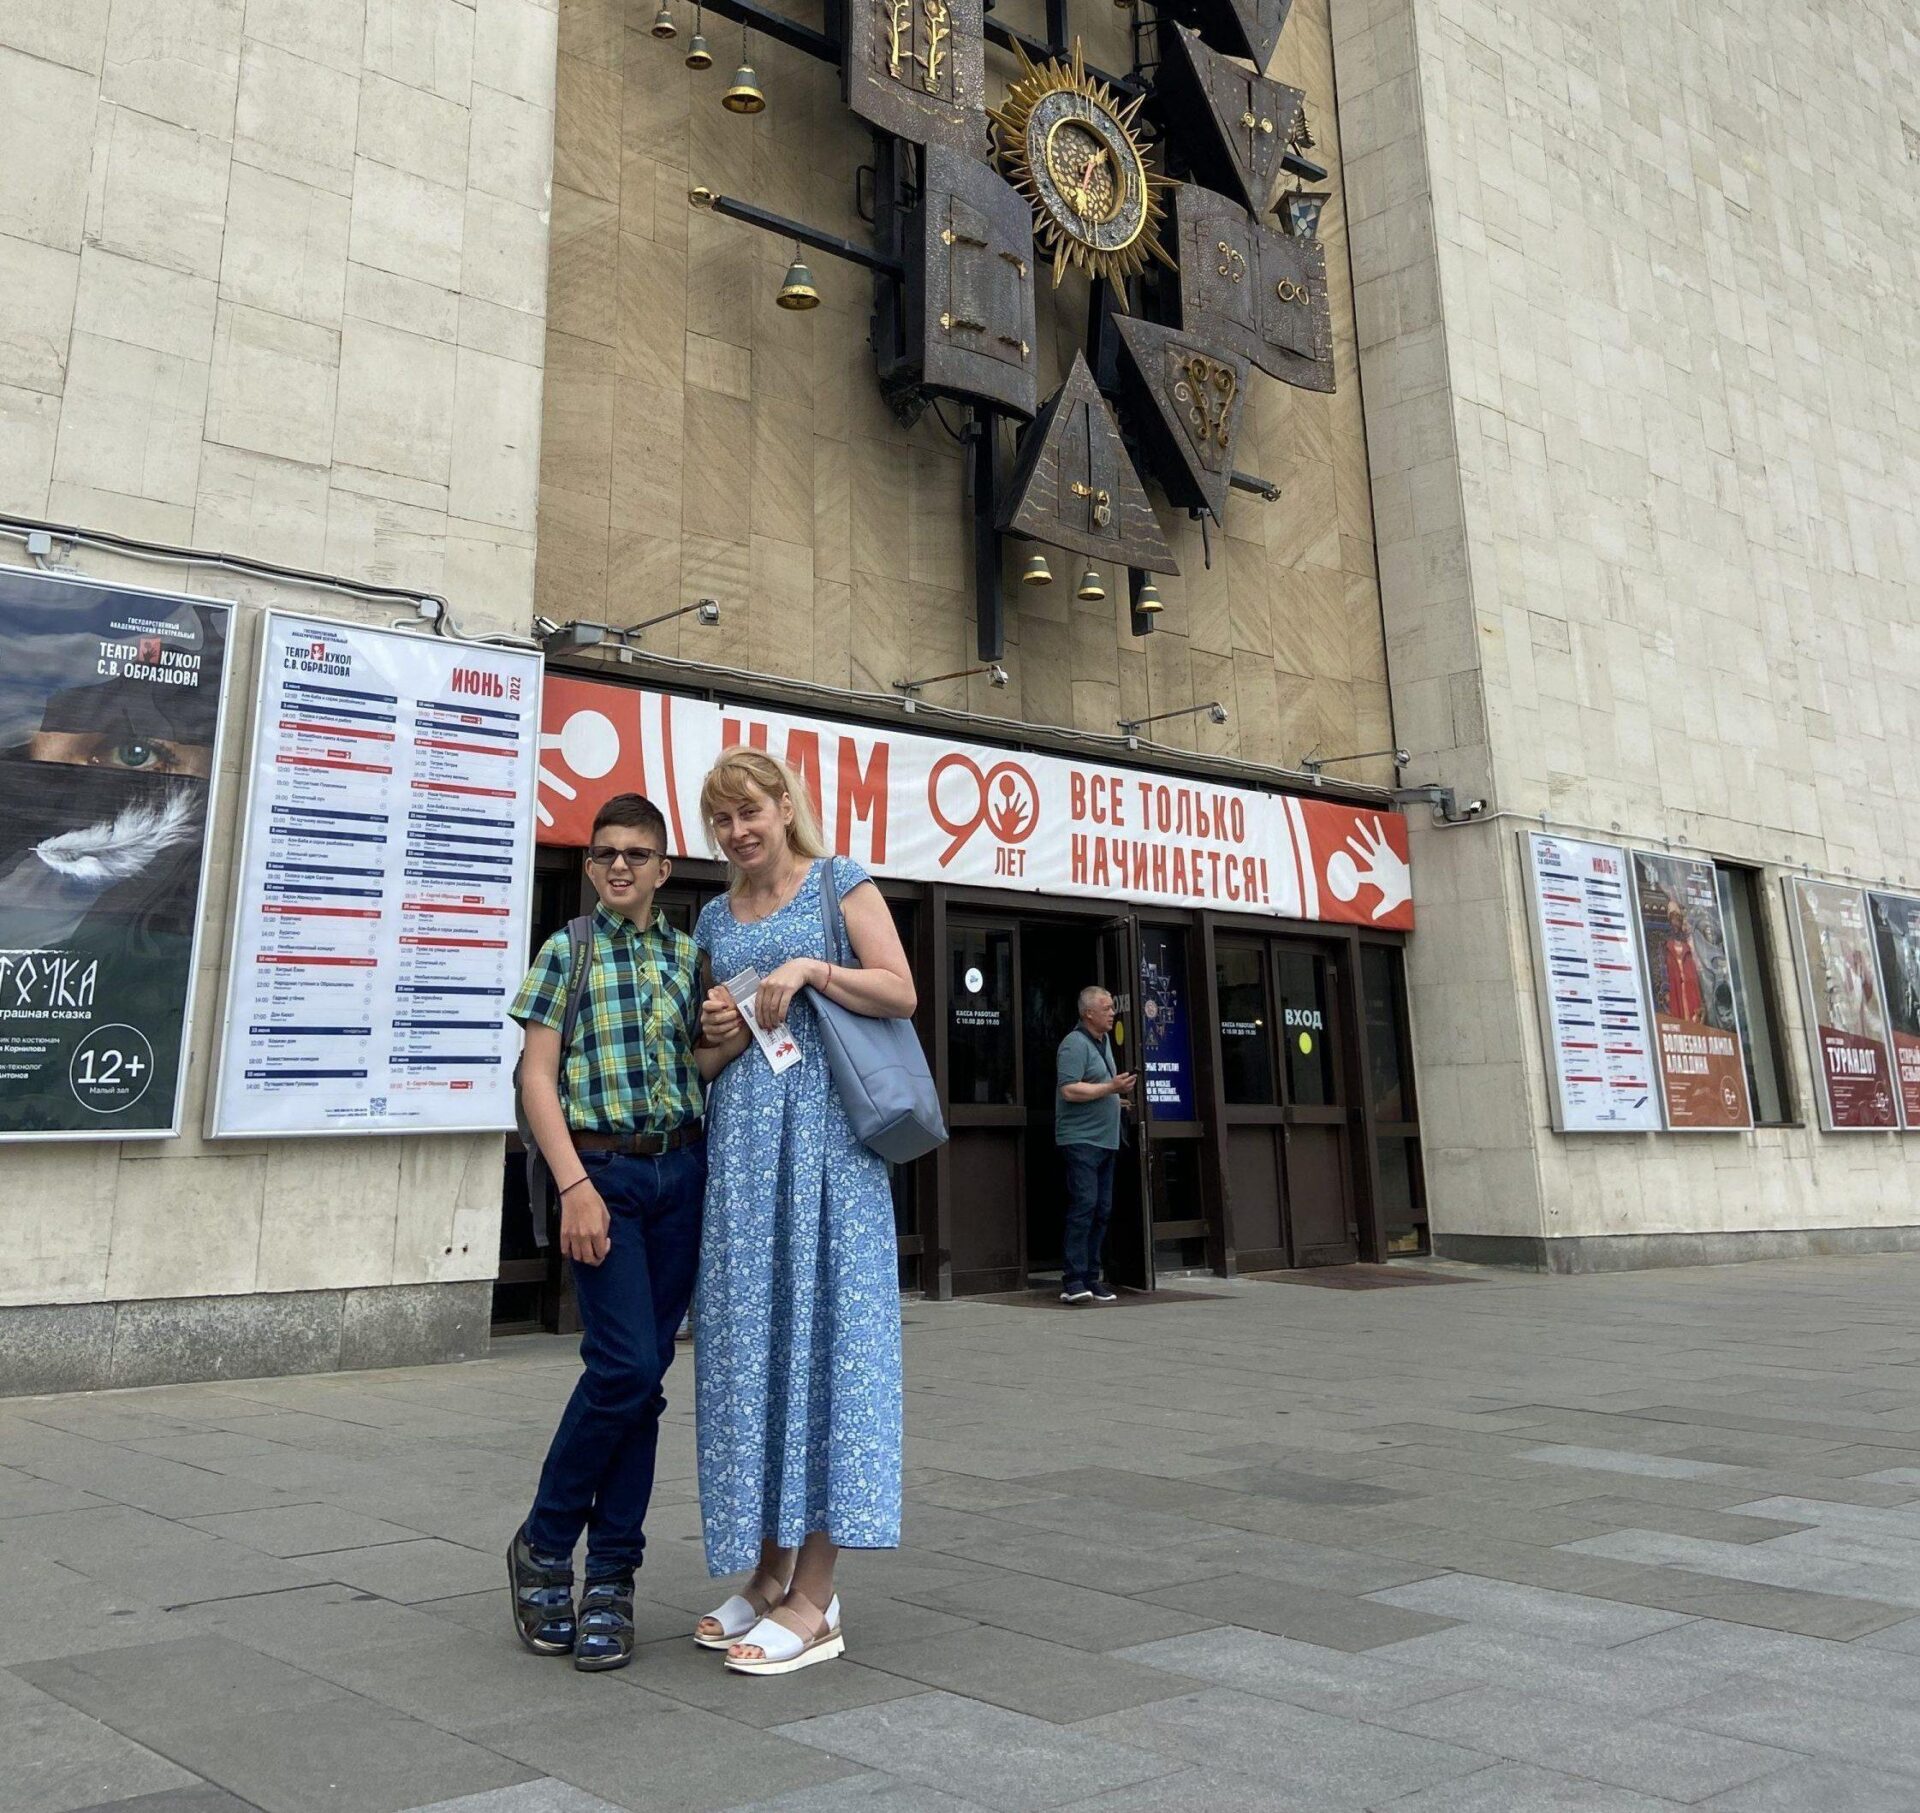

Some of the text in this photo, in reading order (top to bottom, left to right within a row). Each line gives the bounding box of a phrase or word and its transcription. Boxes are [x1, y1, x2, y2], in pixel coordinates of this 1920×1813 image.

[100, 642, 201, 670] ТЕАТР КУКОЛ
[283, 658, 351, 678] С.В. ОБРАЗЦОВА
[285, 646, 352, 666] ТЕАТР КУКОЛ
[97, 659, 199, 687] С.В. ОБРАЗЦОВА
[451, 667, 504, 699] ИЮНЬ
[509, 676, 522, 701] 2022
[928, 752, 1040, 868] 90
[1069, 770, 1245, 844] ВСЕ ТОЛЬКО
[994, 846, 1027, 878] ЛЕТ
[1070, 832, 1271, 905] НАЧИНАЕТСЯ!
[52, 1011, 91, 1019] сказка
[1285, 1008, 1322, 1030] ВХОД
[78, 1050, 145, 1084] 12+
[1826, 1046, 1876, 1074] ТУРАНДОТ
[1724, 1088, 1737, 1106] 6+
